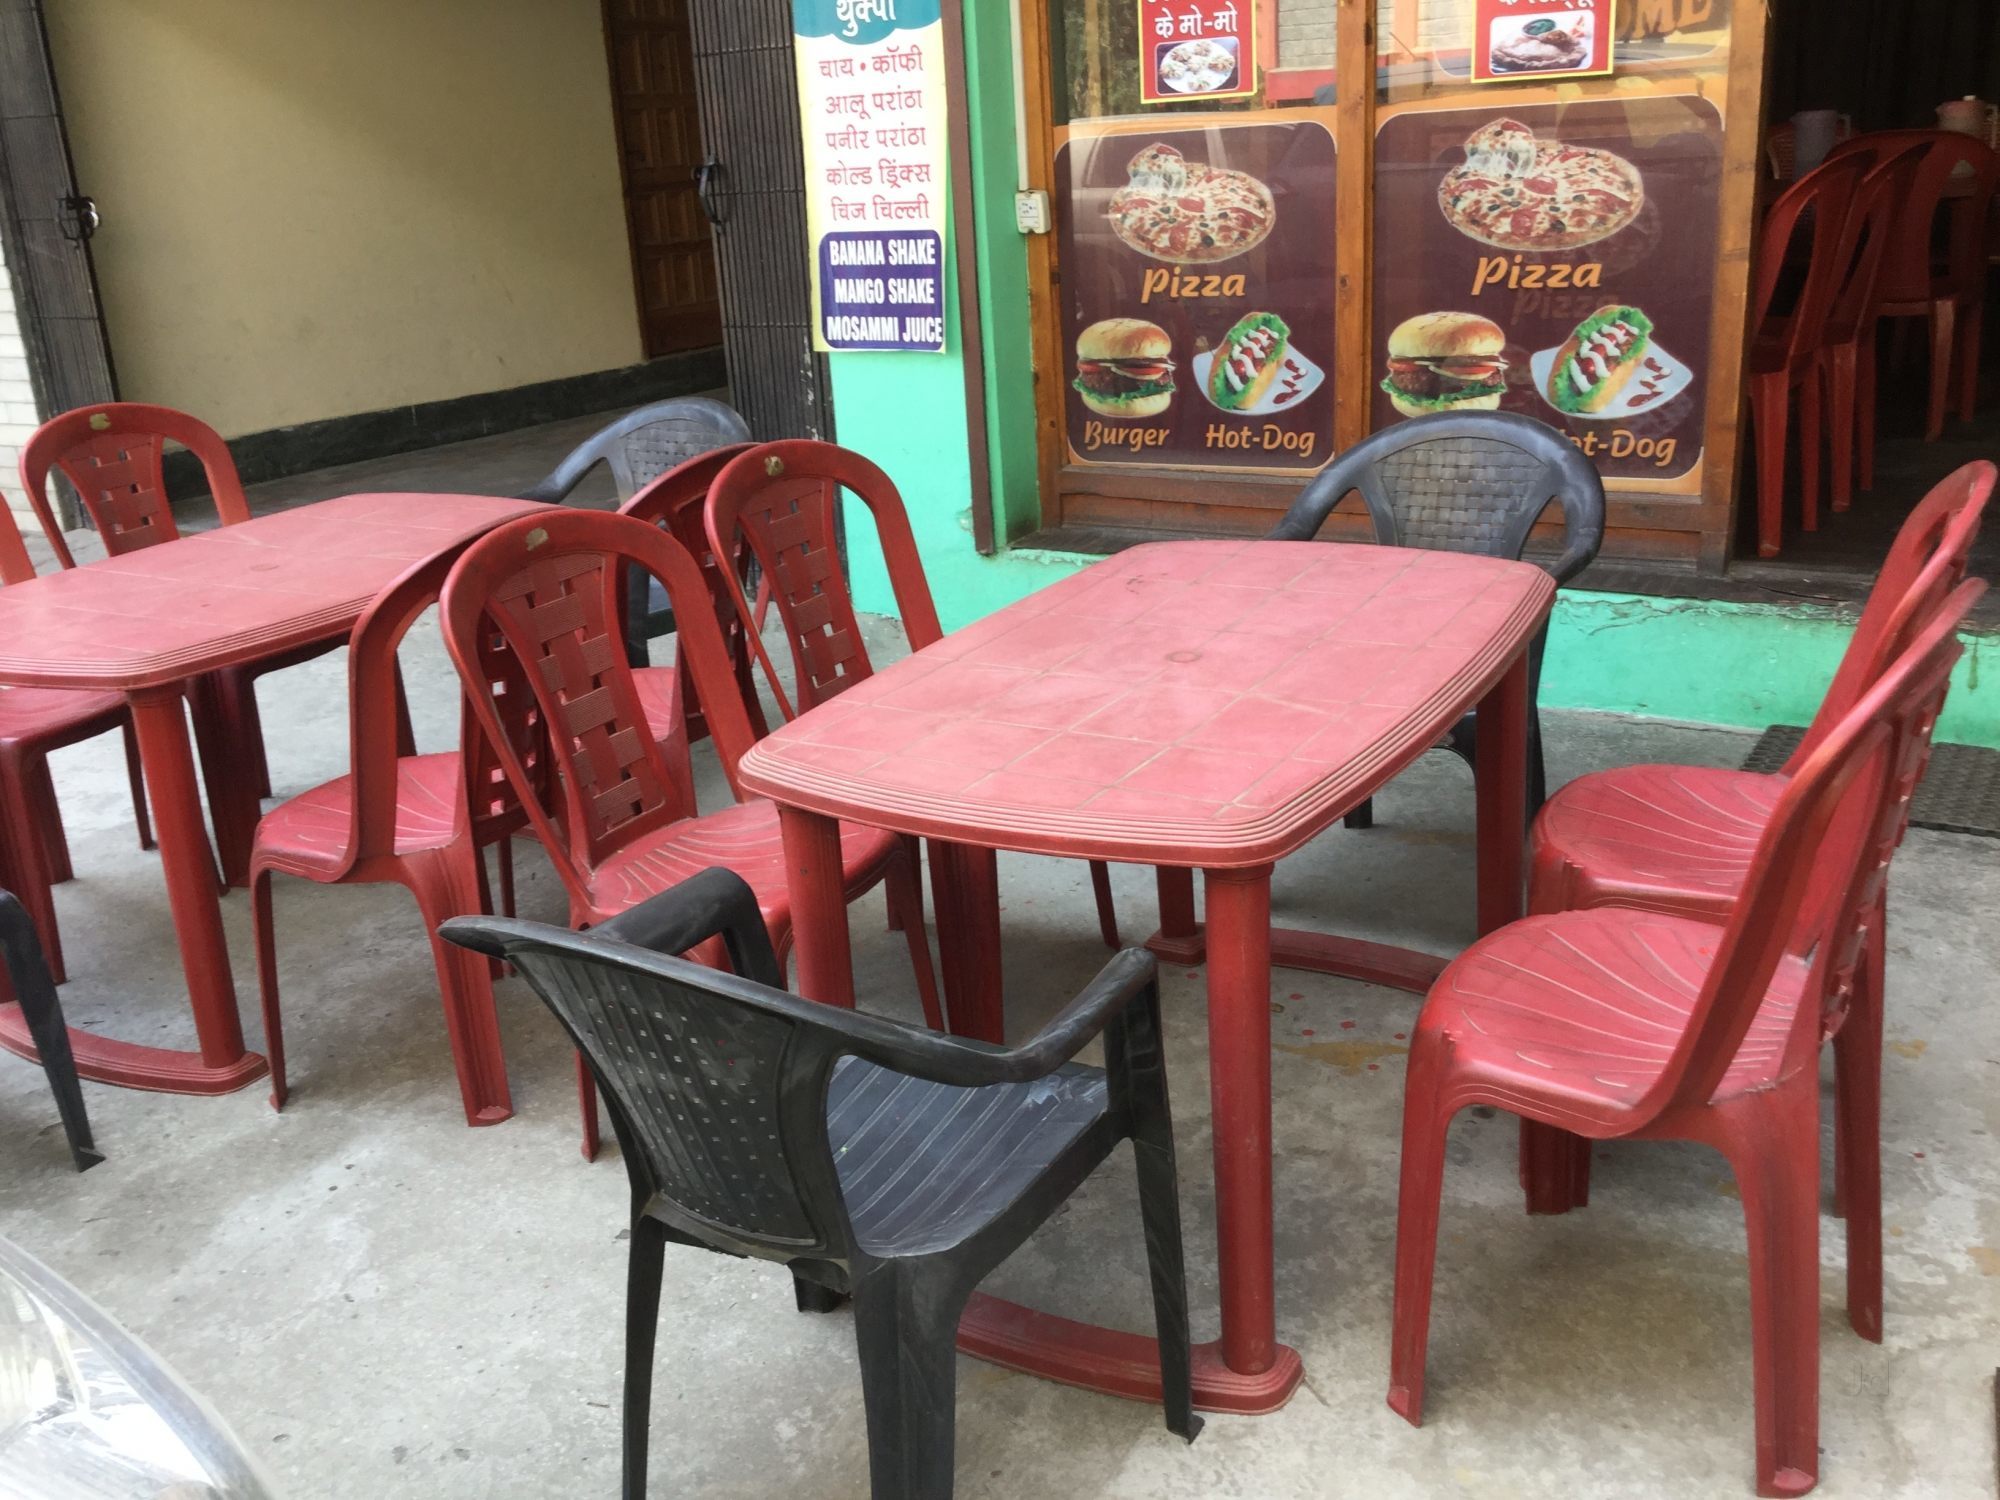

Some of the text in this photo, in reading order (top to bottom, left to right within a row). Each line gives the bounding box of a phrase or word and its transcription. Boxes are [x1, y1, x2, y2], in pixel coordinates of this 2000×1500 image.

[1154, 0, 1239, 38] के मो-मो
[819, 44, 923, 78] चाय कॉफी
[826, 84, 923, 119] आलू परांठा
[825, 121, 926, 151] पनीर परांठा
[825, 160, 873, 186] कोल्ड
[829, 238, 936, 266] BANANA SHAKE
[833, 277, 935, 304] MANGO SHAKE
[826, 315, 943, 343] MOSAMMI JUICE
[1084, 420, 1316, 458] Burger Hot-Dog
